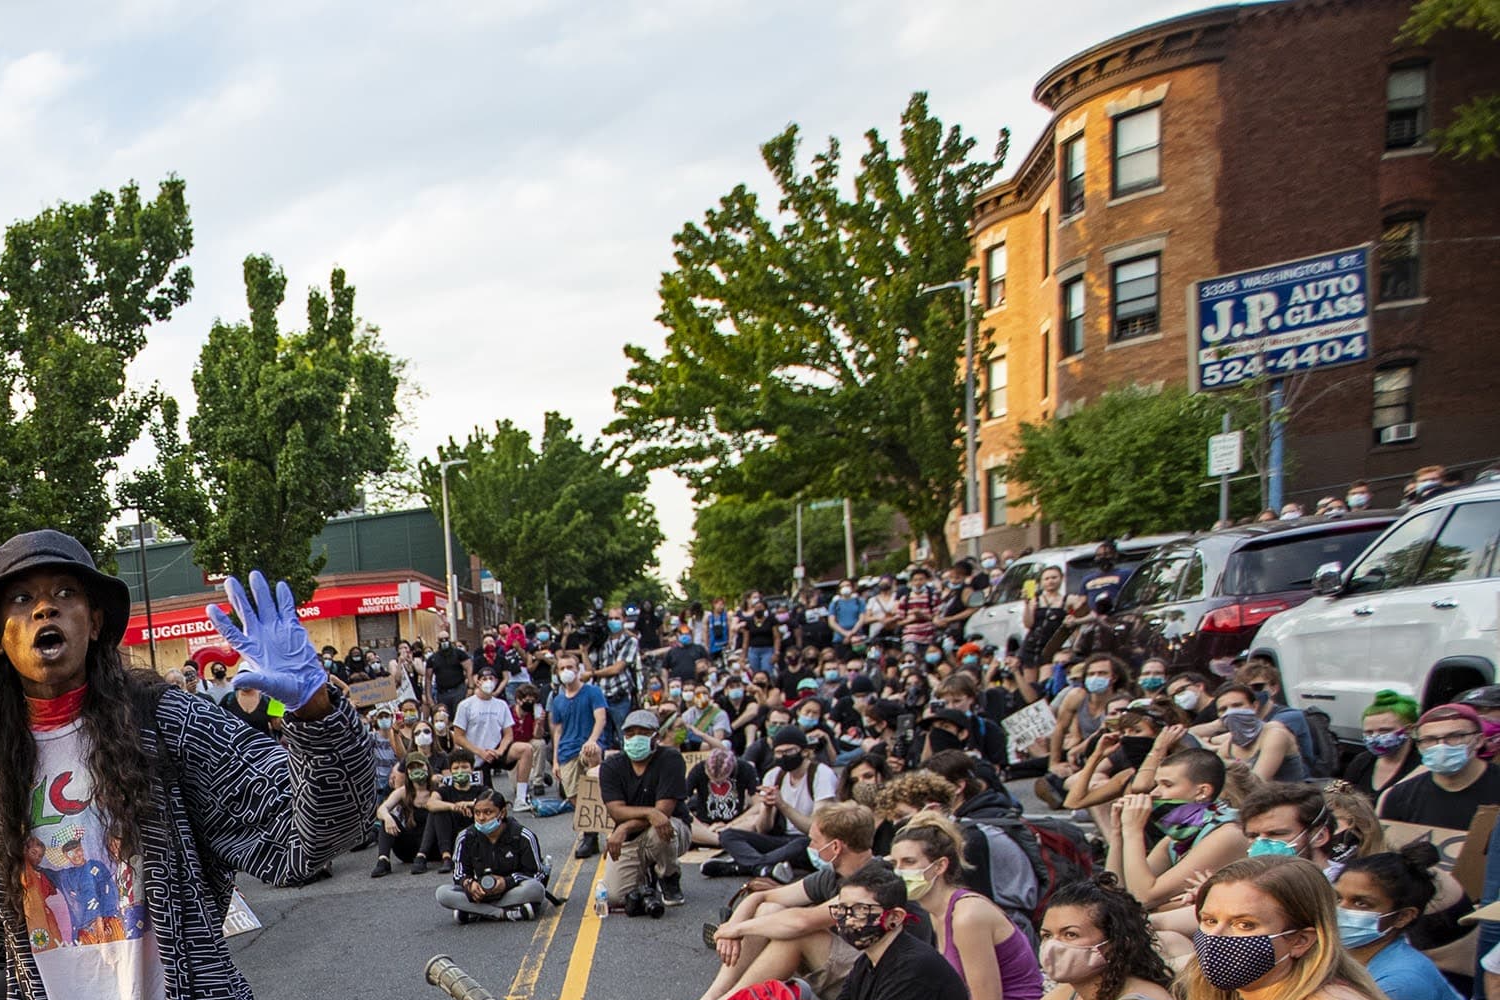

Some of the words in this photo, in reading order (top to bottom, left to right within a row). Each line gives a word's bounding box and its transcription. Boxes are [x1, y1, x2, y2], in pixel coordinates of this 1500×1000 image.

[1241, 259, 1334, 290] WASHINGTON
[1288, 274, 1360, 306] AUTO
[1202, 292, 1282, 342] J.P.
[1284, 294, 1366, 327] GLASS
[1202, 335, 1366, 386] 524-4404
